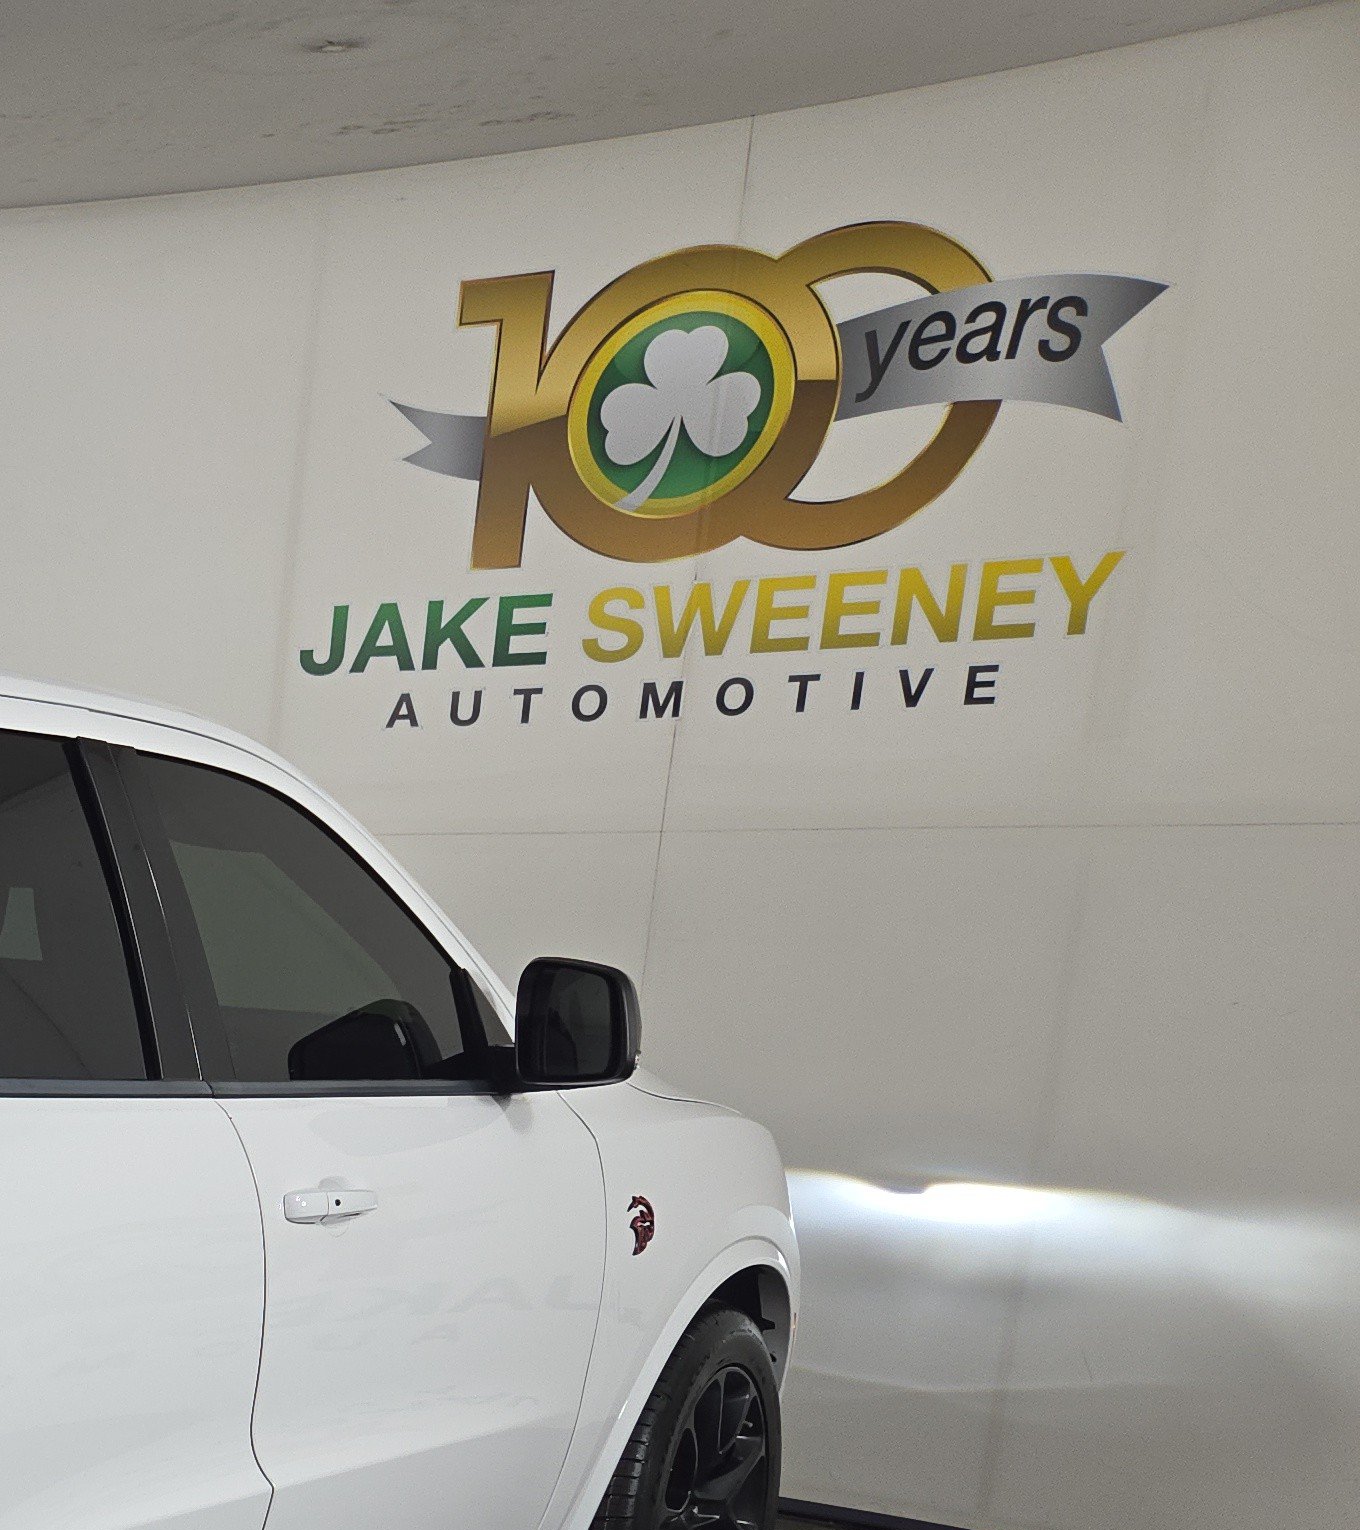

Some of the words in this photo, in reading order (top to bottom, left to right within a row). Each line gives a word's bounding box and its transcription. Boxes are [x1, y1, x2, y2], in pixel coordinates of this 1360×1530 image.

[456, 220, 1003, 570] 100
[854, 294, 1089, 403] years
[299, 591, 555, 676] JAKE
[581, 550, 1127, 665] SWEENEY
[385, 663, 1003, 730] AUTOMOTIVE
